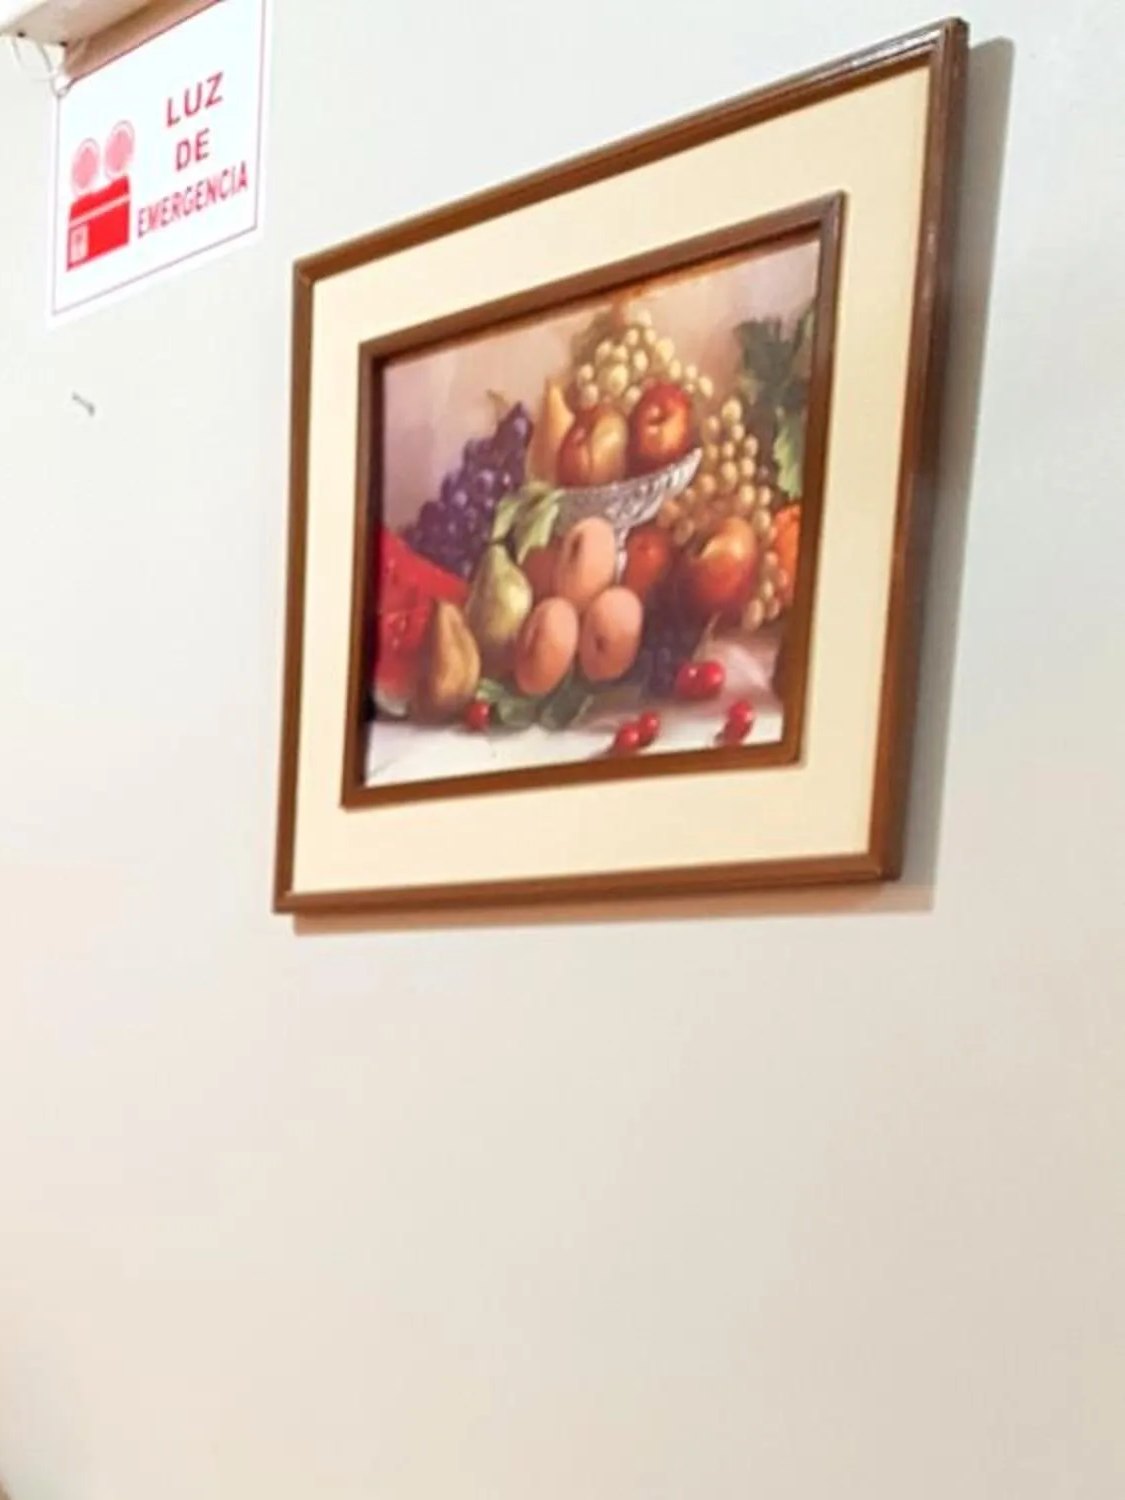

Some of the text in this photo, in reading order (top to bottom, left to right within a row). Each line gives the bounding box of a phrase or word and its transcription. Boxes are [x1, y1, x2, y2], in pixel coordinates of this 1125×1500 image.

[166, 72, 223, 127] LUZ
[176, 128, 210, 171] DE
[138, 161, 248, 238] EMERGENCIA
